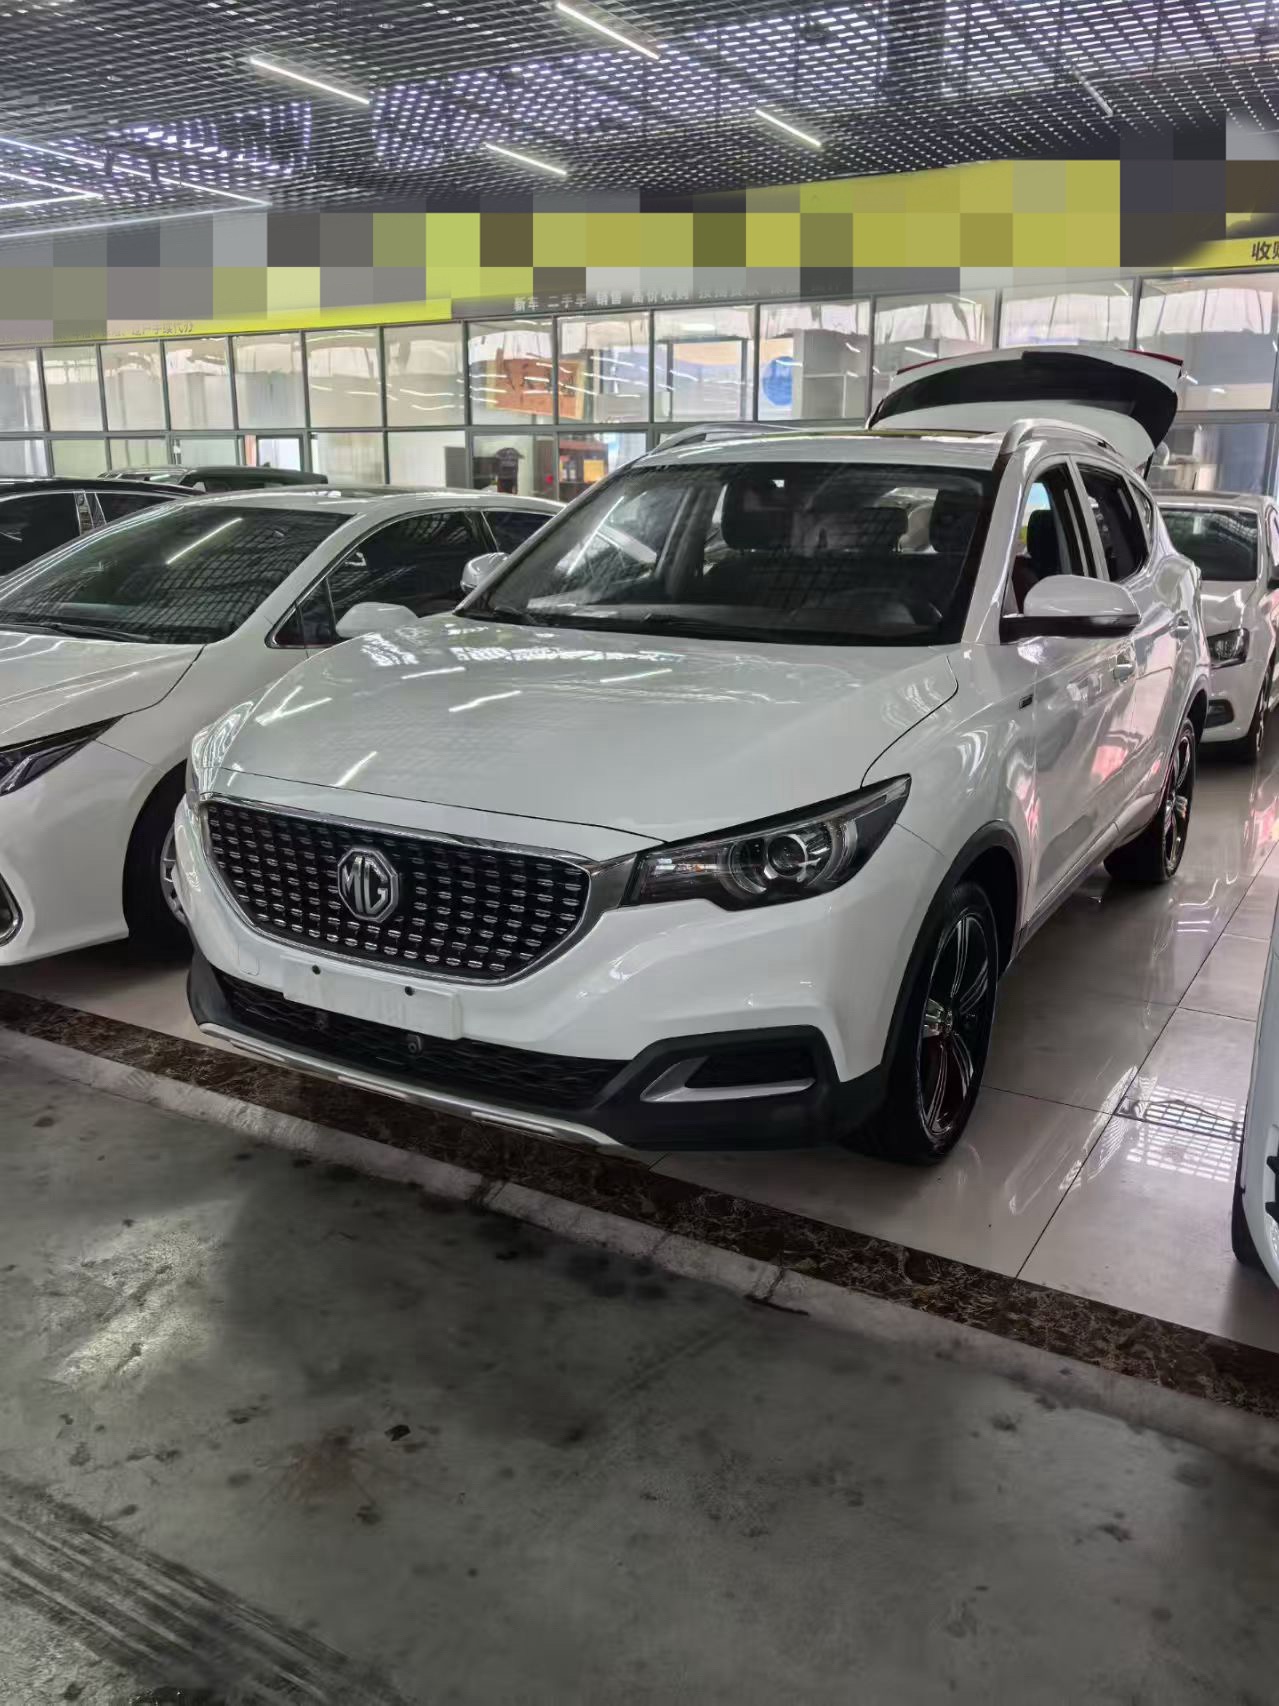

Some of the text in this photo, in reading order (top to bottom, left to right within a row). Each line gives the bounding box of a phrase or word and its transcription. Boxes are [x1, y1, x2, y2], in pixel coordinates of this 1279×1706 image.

[513, 296, 539, 312] 新车
[547, 293, 587, 309] 二手车
[342, 856, 389, 914] MG
